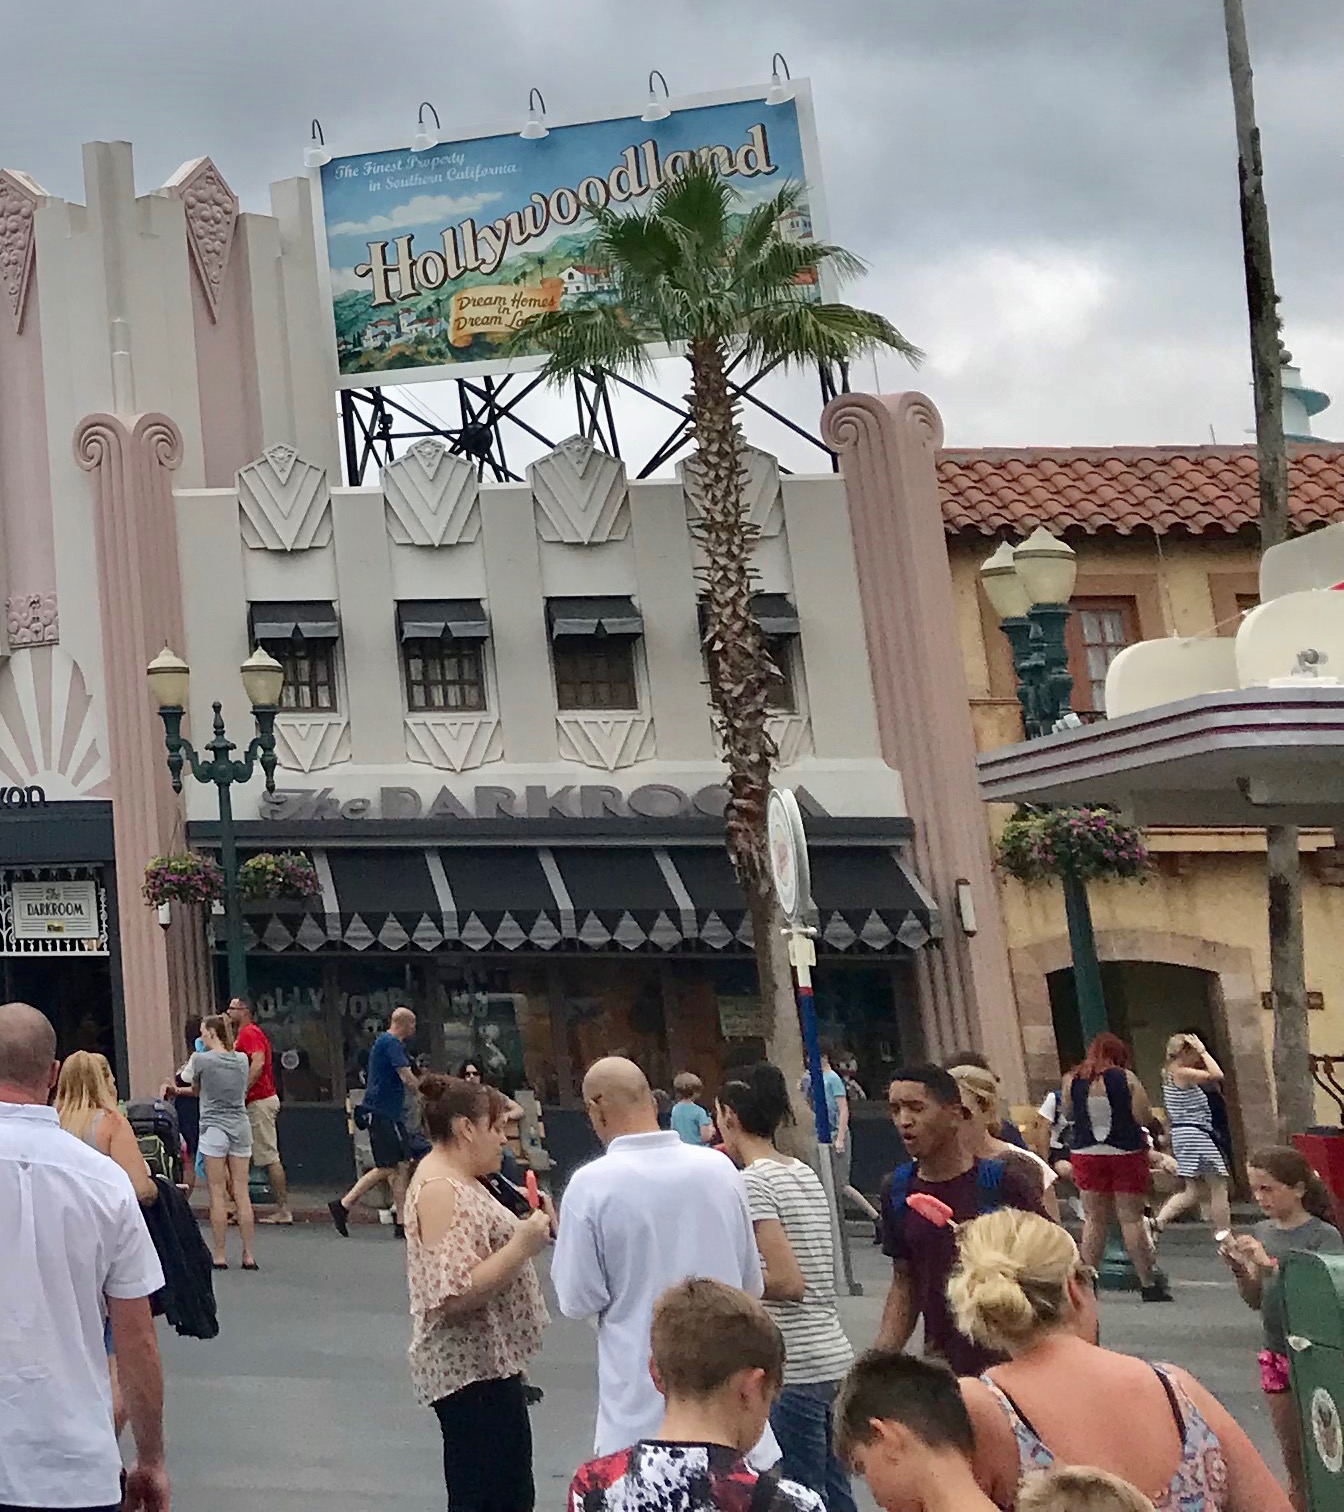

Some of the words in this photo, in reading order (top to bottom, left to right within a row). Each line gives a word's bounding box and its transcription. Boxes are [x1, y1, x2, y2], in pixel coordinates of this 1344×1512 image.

[335, 165, 359, 180] The
[363, 160, 403, 176] Finest
[406, 152, 465, 170] Property
[368, 180, 381, 192] in
[385, 172, 443, 190] Southern
[446, 163, 518, 182] California
[355, 123, 779, 307] Hollywoodland
[457, 295, 507, 311] Dream
[511, 291, 556, 309] Homes
[497, 305, 511, 315] in
[454, 315, 503, 331] Dream
[257, 785, 371, 822] The
[380, 784, 835, 820] DARKROO
[27, 902, 84, 916] DARKROOM
